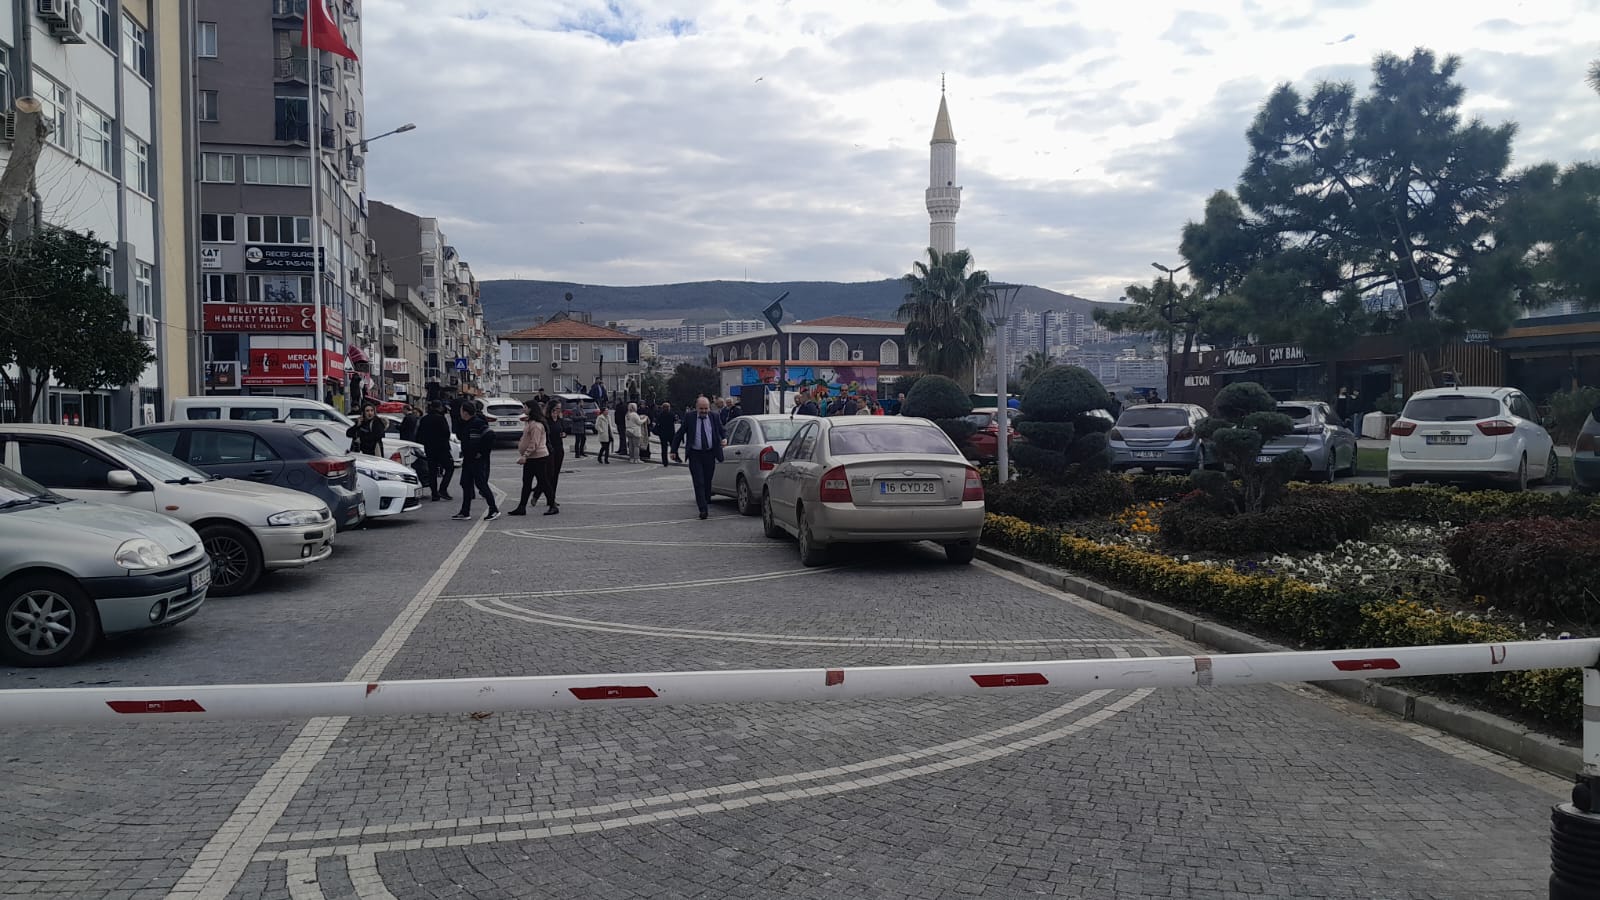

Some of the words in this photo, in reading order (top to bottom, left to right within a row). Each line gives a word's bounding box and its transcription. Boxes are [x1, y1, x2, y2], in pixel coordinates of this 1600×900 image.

[214, 315, 256, 323] HAREKET
[1225, 350, 1258, 367] Milton
[1269, 347, 1284, 364] ÇAY
[886, 483, 896, 493] 16
[900, 483, 920, 493] CYD
[923, 483, 935, 493] 28
